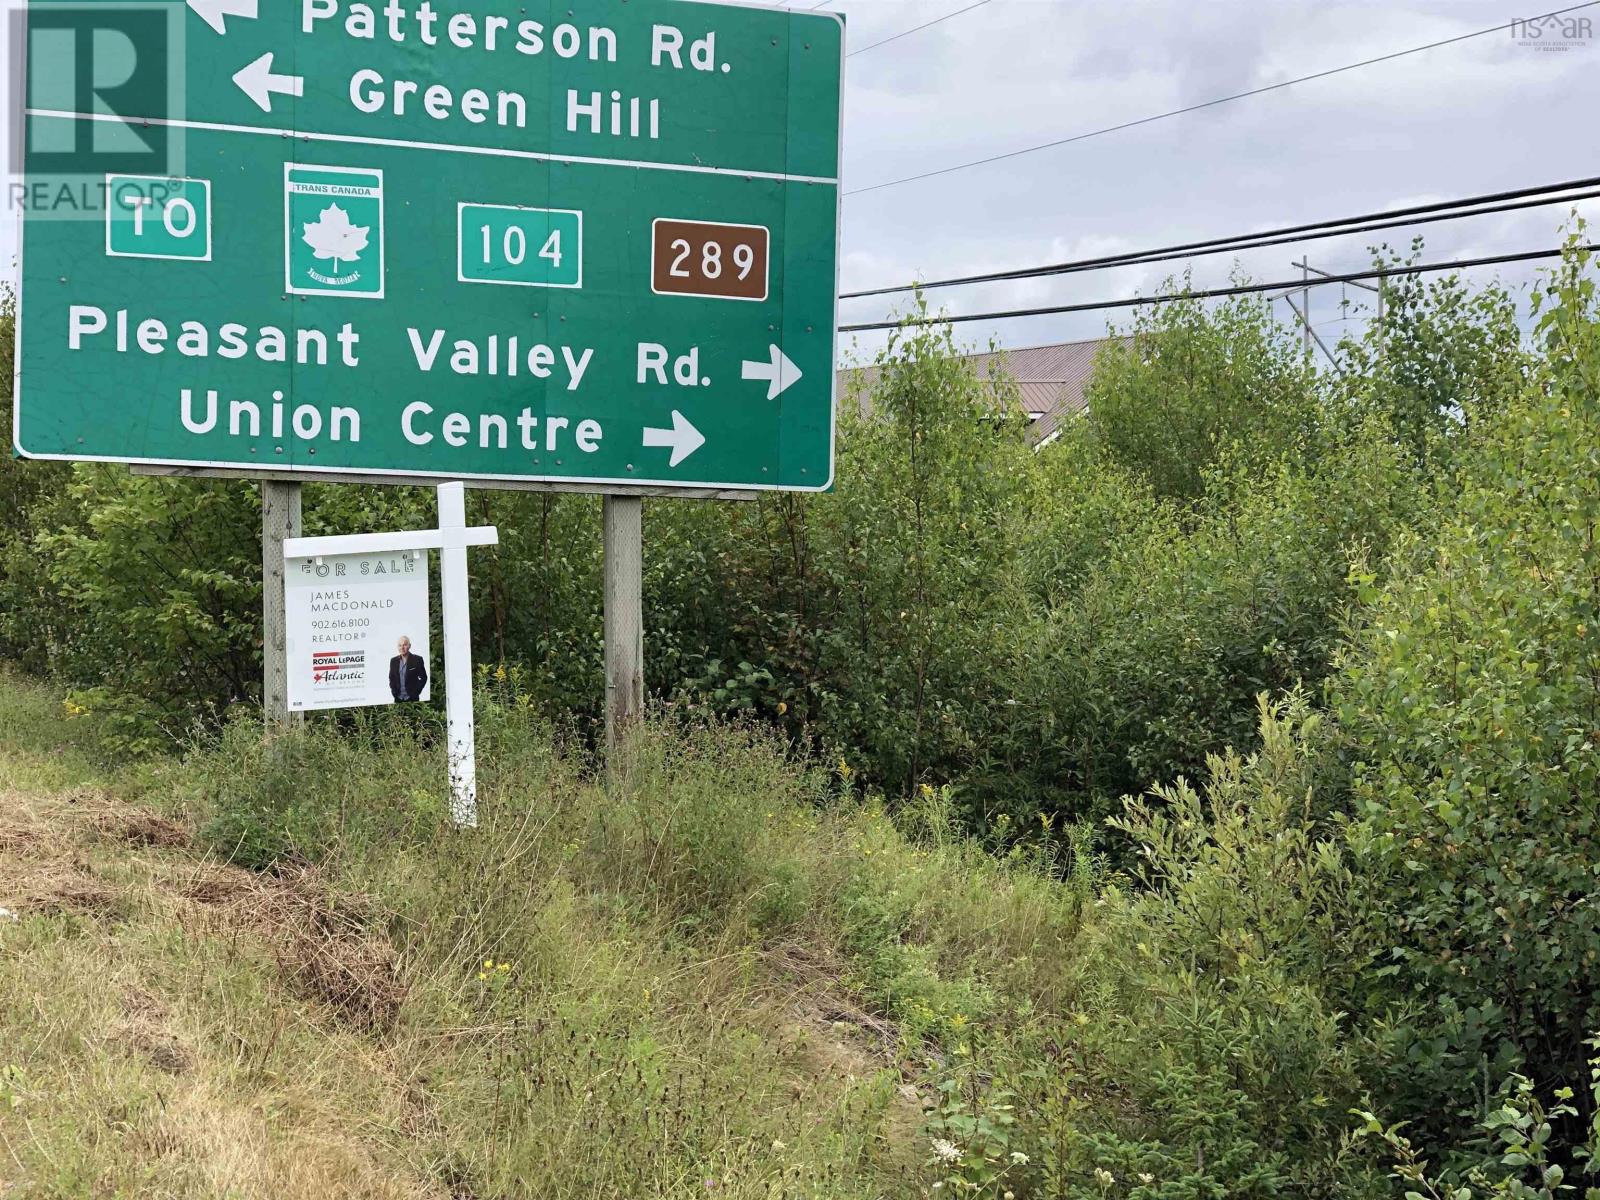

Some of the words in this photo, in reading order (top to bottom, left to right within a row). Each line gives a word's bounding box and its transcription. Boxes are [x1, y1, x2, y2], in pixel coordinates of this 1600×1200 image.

[302, 0, 617, 63] Patterson
[651, 24, 731, 73] Rd.
[349, 69, 527, 130] Green
[567, 89, 659, 139] Hill
[295, 184, 328, 193] TRANS
[331, 186, 371, 195] CANADA
[124, 195, 196, 238] TO
[480, 225, 563, 268] 104
[669, 239, 754, 281] 289
[69, 305, 360, 367] Pleasant
[407, 328, 594, 390] Valley
[636, 342, 711, 387] Rd.
[180, 389, 360, 442] Union
[401, 401, 603, 453] Centre
[360, 559, 415, 575] SALE
[311, 590, 349, 603] JAMES
[311, 599, 394, 612] MACDONALD
[311, 618, 370, 629] 902.616.8100
[312, 657, 337, 665] ROYAL
[319, 670, 365, 682] Atlantic
